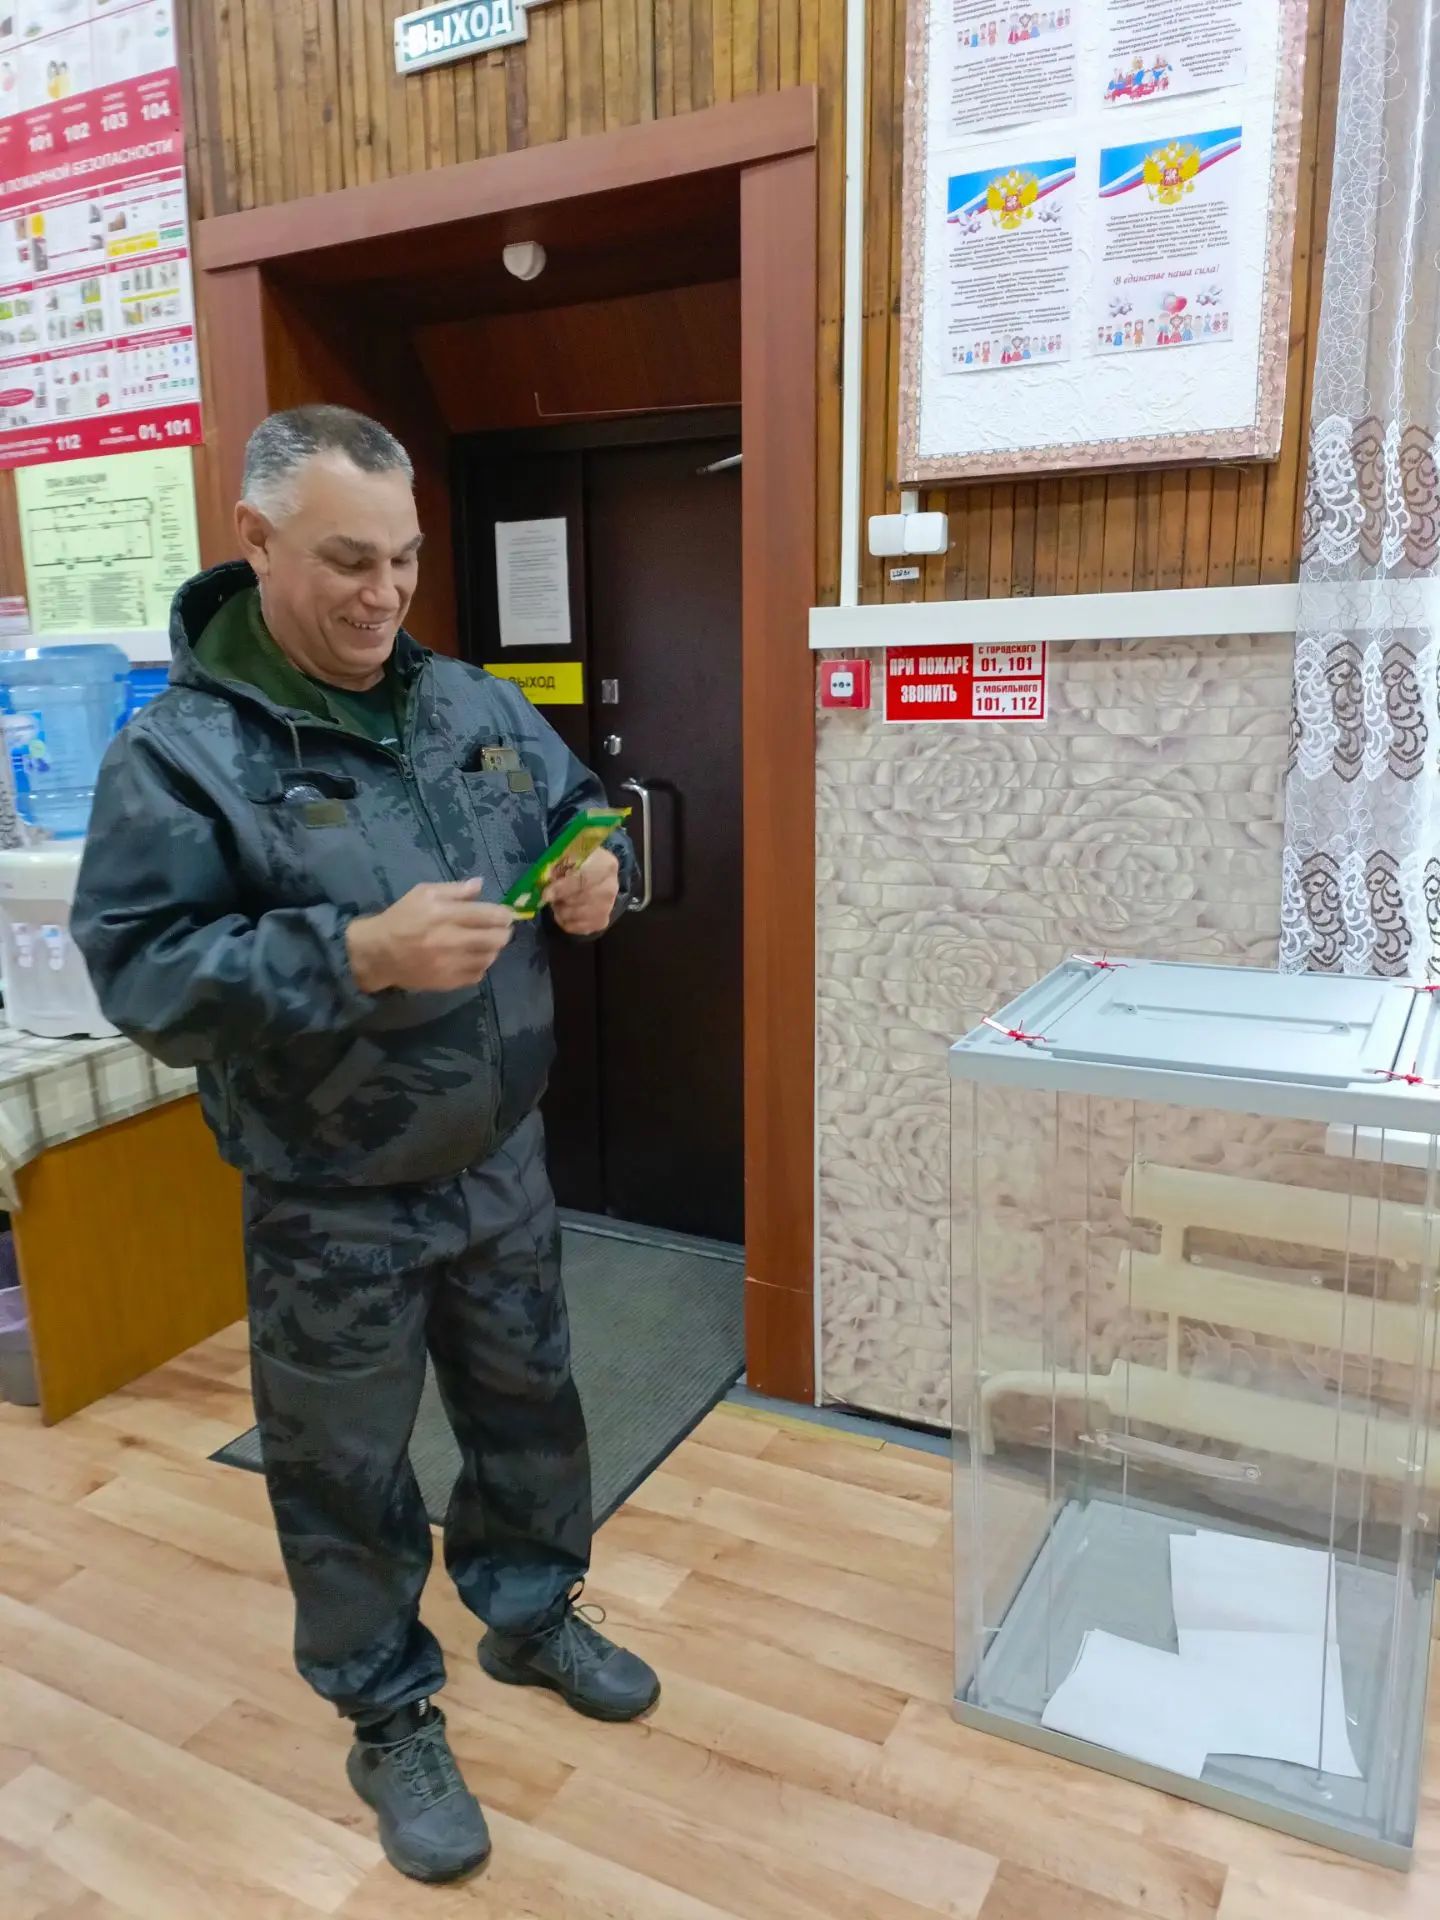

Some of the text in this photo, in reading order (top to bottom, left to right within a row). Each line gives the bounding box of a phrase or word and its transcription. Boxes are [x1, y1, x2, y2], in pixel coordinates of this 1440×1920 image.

[404, 1, 512, 58] ВЫХОД
[141, 100, 171, 120] 104
[100, 111, 128, 132] 103
[164, 418, 192, 436] 101
[56, 434, 82, 451] 112
[986, 644, 1037, 655] ГОРОДСКОГО
[889, 656, 969, 677] ПРИ ПОЖАРЕ
[981, 656, 1033, 673] 01, 101
[900, 684, 958, 703] ЗВОНИТЬ
[983, 683, 1038, 694] МОБИЛЬНОГО
[976, 696, 1037, 713] 101, 112
